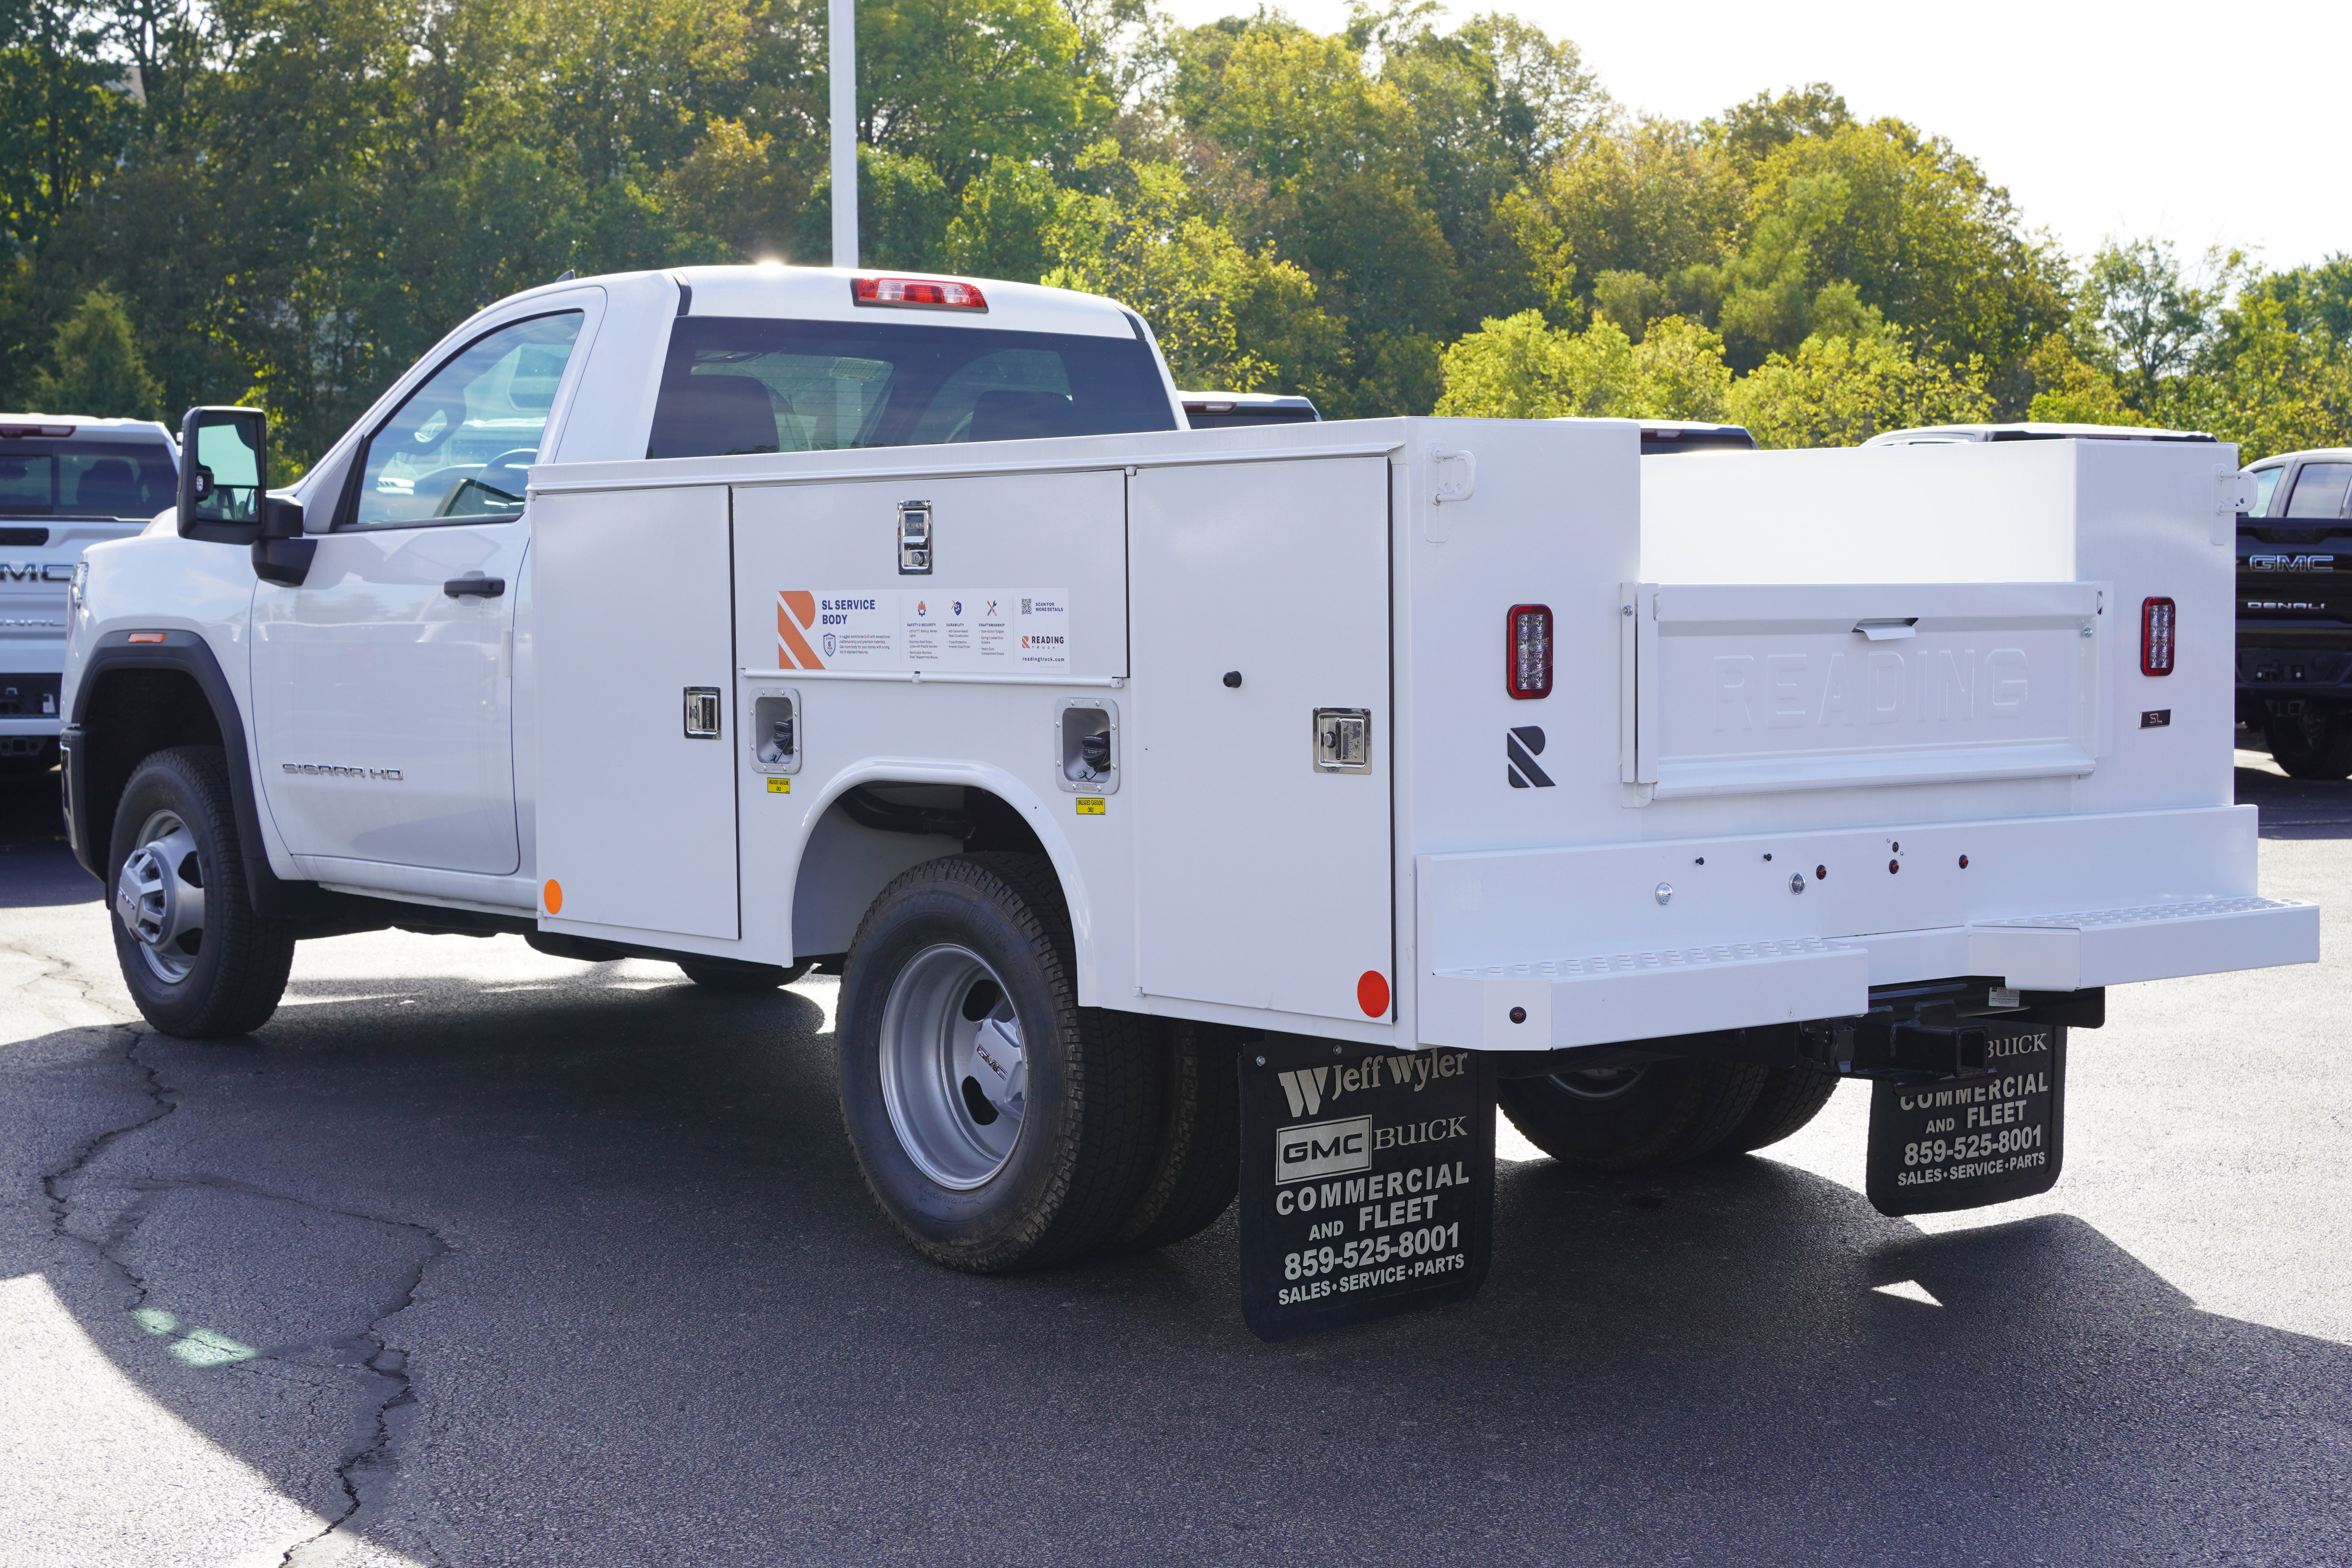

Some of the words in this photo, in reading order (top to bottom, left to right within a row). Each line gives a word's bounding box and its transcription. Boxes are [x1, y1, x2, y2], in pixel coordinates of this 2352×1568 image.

[2249, 555, 2334, 572] GMC
[822, 599, 833, 610] SL
[835, 599, 875, 610] SERVICE
[822, 615, 847, 624] BODY
[2247, 601, 2325, 610] DENALI
[1031, 636, 1064, 644] READING
[1714, 648, 2029, 731] READING
[2149, 713, 2162, 724] SL
[283, 762, 366, 778] SIERRA
[370, 767, 404, 781] HD
[976, 1044, 1008, 1081] GMC
[1332, 1056, 1383, 1101] Jeff
[1387, 1049, 1468, 1092] Wyler
[1373, 1116, 1468, 1150] BUICK
[1925, 1118, 1955, 1134] AND
[1967, 1100, 2027, 1129] FLEET
[1283, 1134, 1363, 1164] GMC
[1904, 1125, 2041, 1166] 859-525-8001
[1276, 1161, 1470, 1215] COMMERCIAL
[1309, 1220, 1344, 1241] AND
[1359, 1194, 1439, 1232] FLEET
[1285, 1221, 1459, 1281] 859-525-8001
